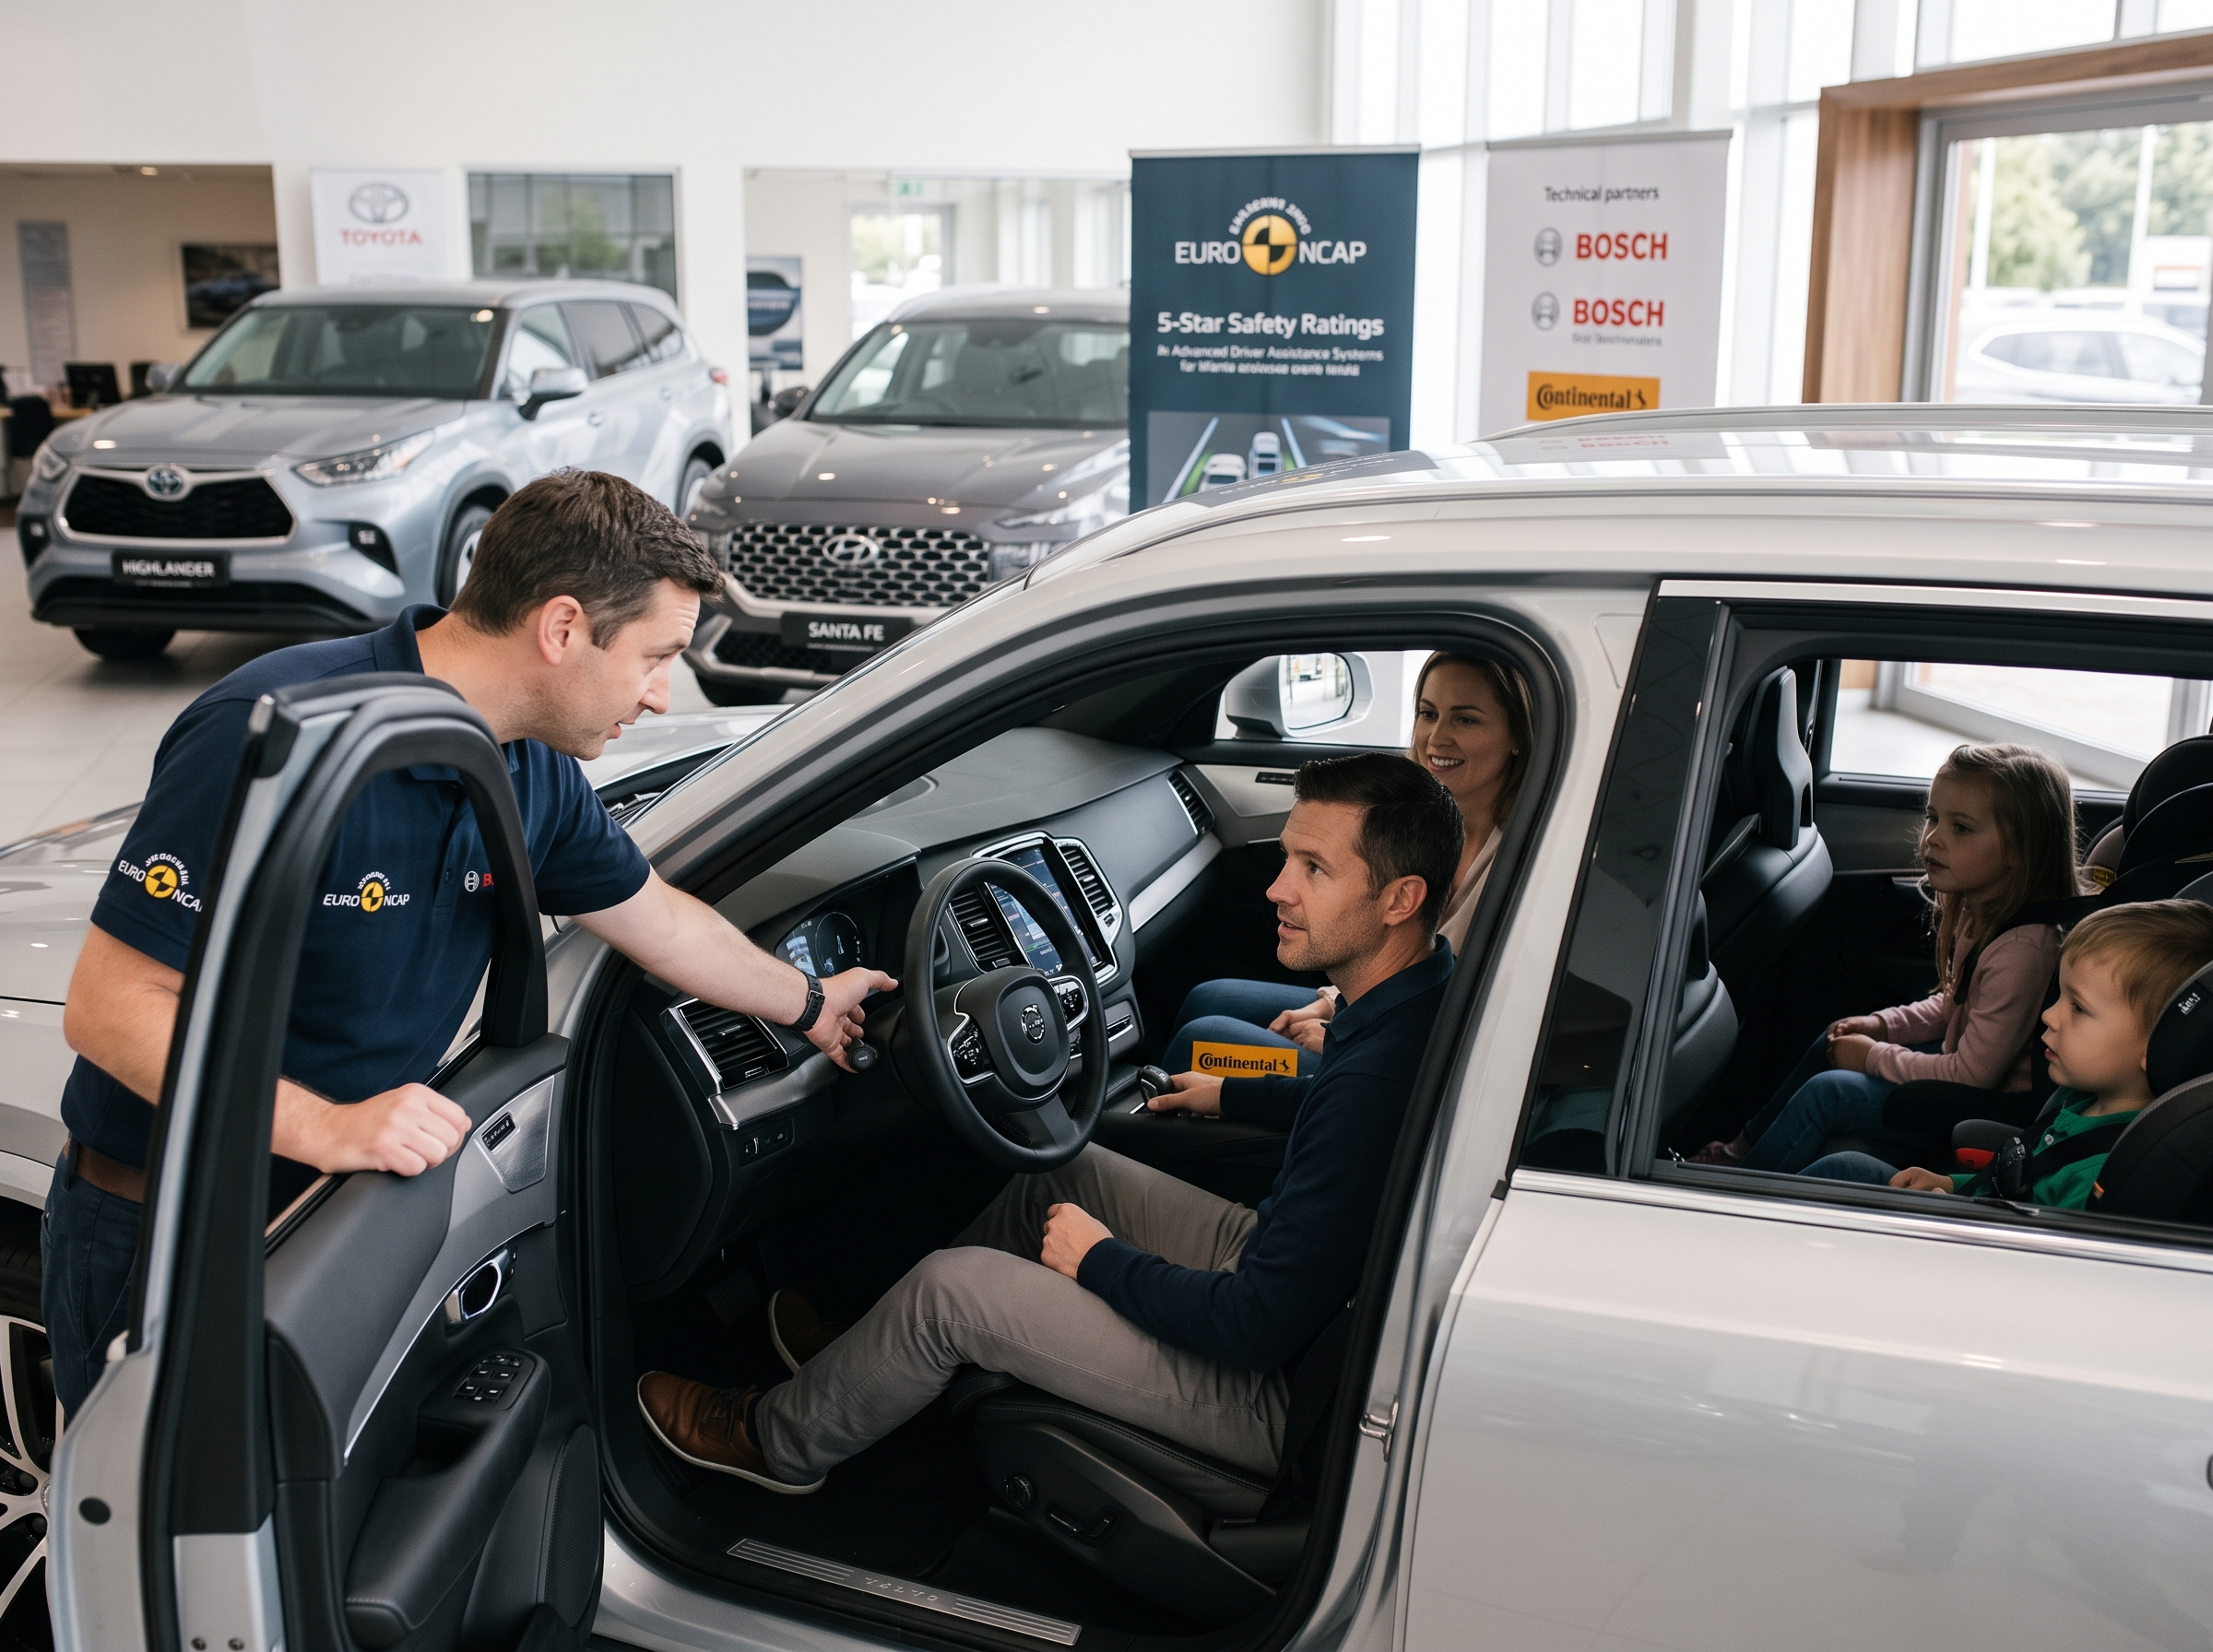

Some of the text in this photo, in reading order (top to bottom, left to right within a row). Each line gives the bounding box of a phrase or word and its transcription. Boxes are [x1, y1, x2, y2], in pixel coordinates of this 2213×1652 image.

[1544, 186, 1660, 204] Technical partners
[339, 228, 423, 247] TOYOTA
[1575, 231, 1669, 260] BOSCH
[1175, 241, 1367, 265] EURO NCAP
[1572, 299, 1665, 327] BOSCH
[1157, 312, 1385, 341] 5-Star Safety Ratings
[1536, 384, 1631, 410] Continental
[808, 621, 885, 642] SANTA FE
[117, 859, 147, 882] EURO
[172, 889, 203, 913] NCA
[323, 893, 410, 907] EURO NCAP
[1198, 1052, 1277, 1072] Continental
